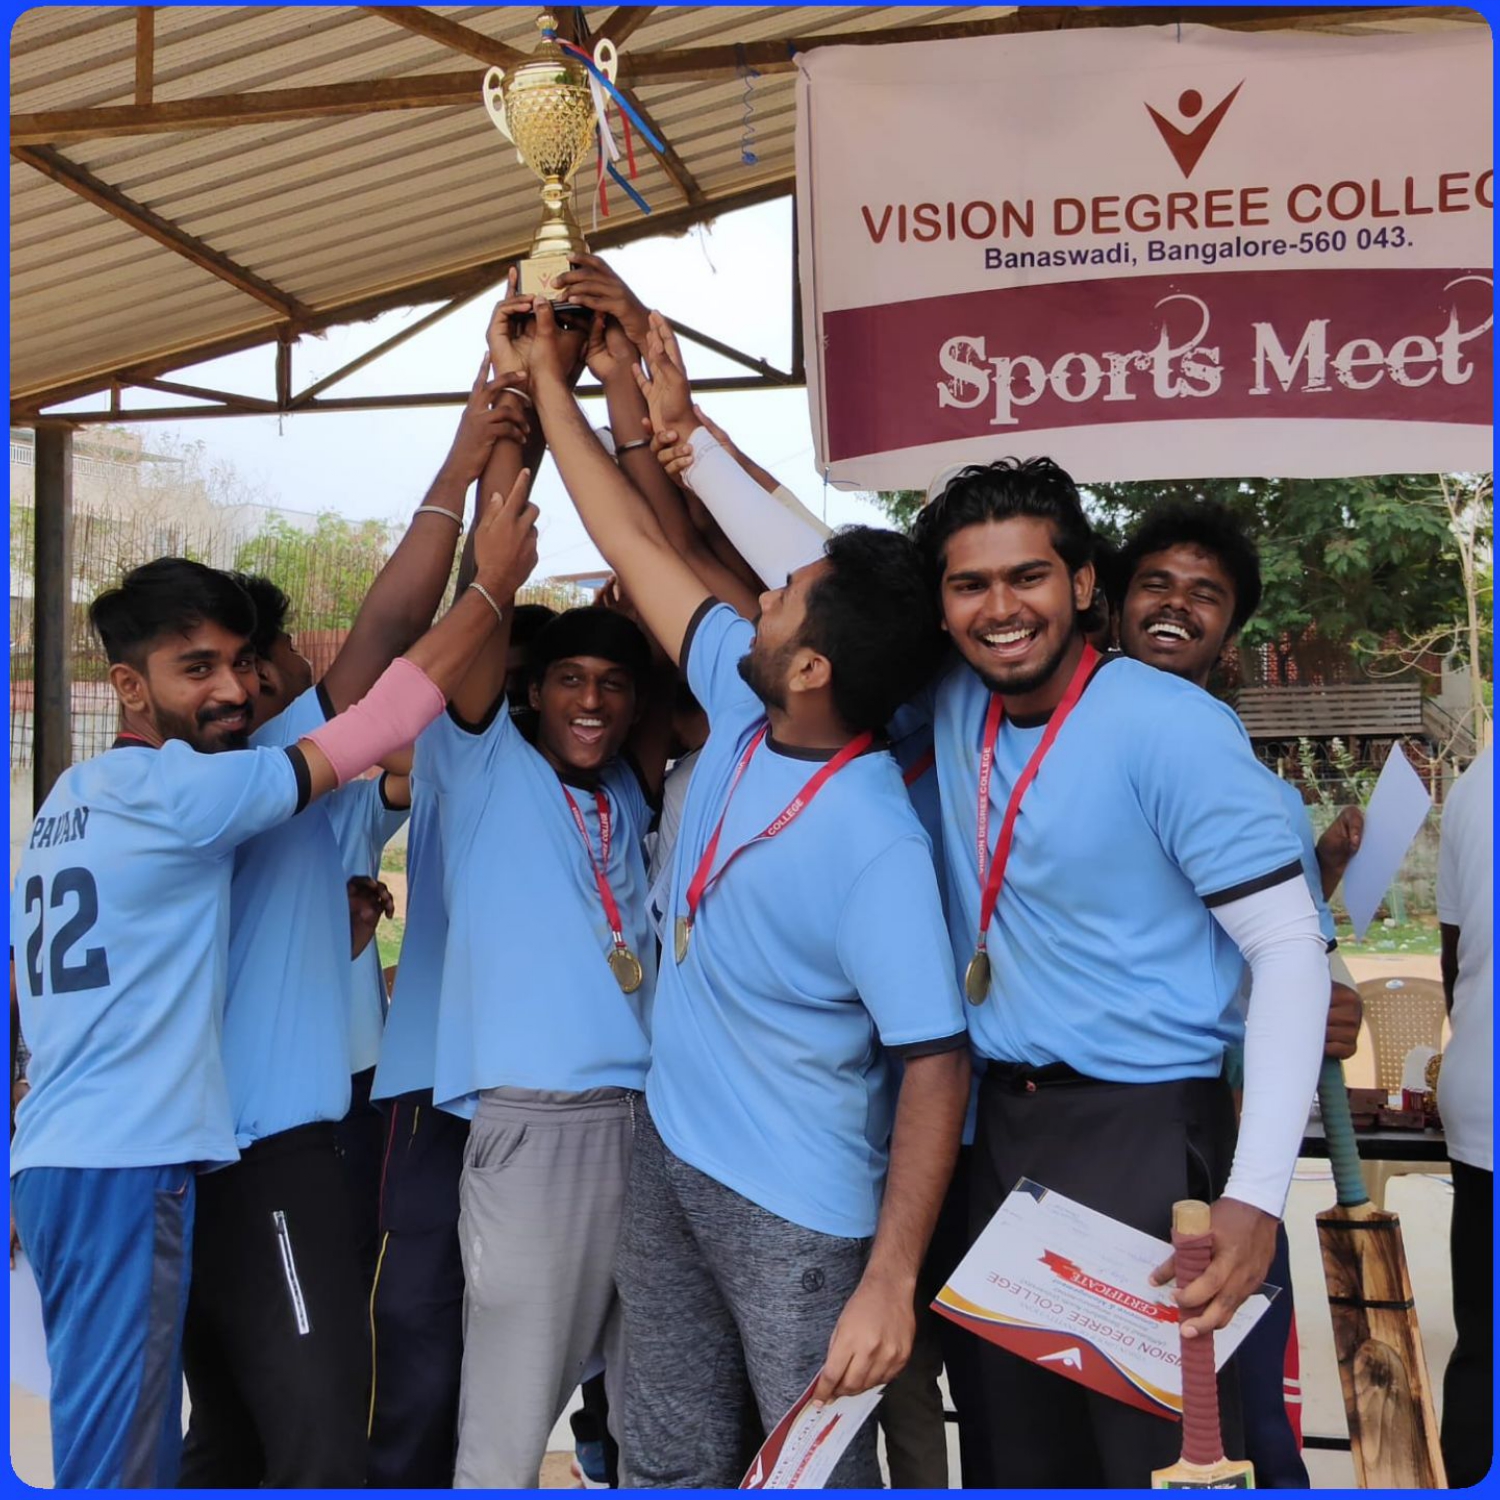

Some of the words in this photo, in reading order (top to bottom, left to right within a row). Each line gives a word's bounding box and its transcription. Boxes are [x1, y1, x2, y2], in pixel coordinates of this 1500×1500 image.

[862, 199, 1036, 244] VISION
[1053, 186, 1270, 236] DEGREE
[984, 239, 1139, 271] Banaswadi,
[1147, 230, 1348, 266] Bangalore-560
[1356, 225, 1415, 252] 043.
[936, 292, 1222, 425] Sports
[1248, 276, 1493, 396] Meet
[980, 746, 992, 793] COLLEGE
[29, 806, 90, 850] PAVAN
[767, 798, 804, 836] COLLEGE
[25, 866, 111, 996] 22
[986, 1270, 1064, 1315] COLLEGE
[1071, 1270, 1158, 1316] CERTIFICATE
[1067, 1310, 1135, 1347] DEGREE
[1138, 1341, 1182, 1367] ISION
